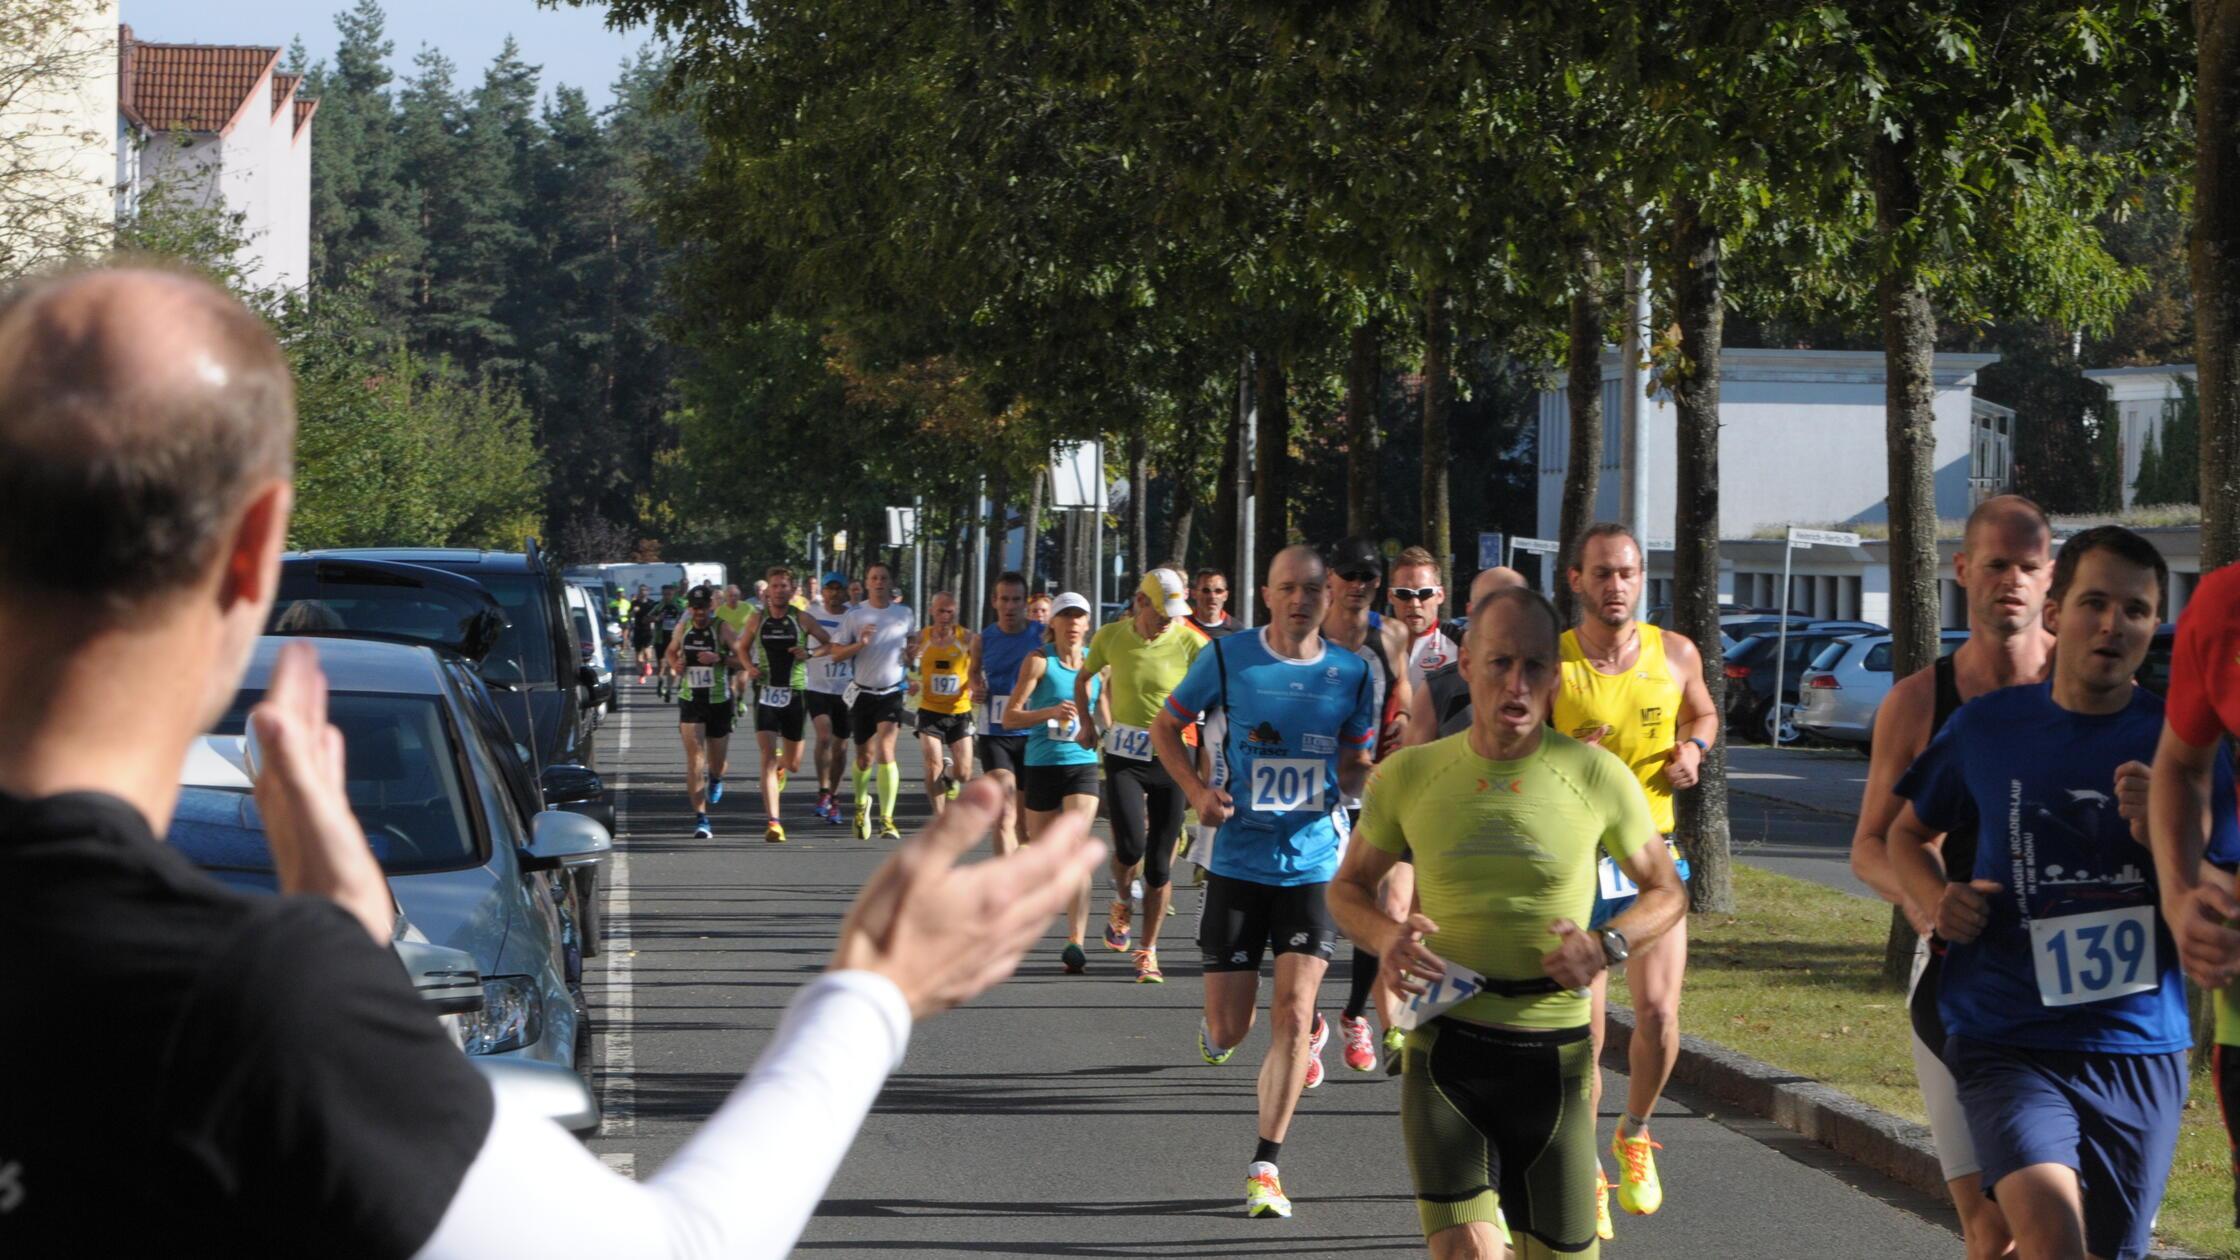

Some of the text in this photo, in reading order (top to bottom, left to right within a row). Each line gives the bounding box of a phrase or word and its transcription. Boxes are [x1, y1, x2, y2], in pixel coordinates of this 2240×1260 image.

[690, 669, 711, 687] 114
[824, 662, 847, 678] 172
[934, 677, 957, 693] 197
[764, 688, 790, 704] 165
[1114, 728, 1149, 756] 142
[1256, 766, 1315, 805] 201
[2027, 867, 2036, 883] DIE
[2028, 884, 2037, 895] IN
[2046, 919, 2145, 995] 139
